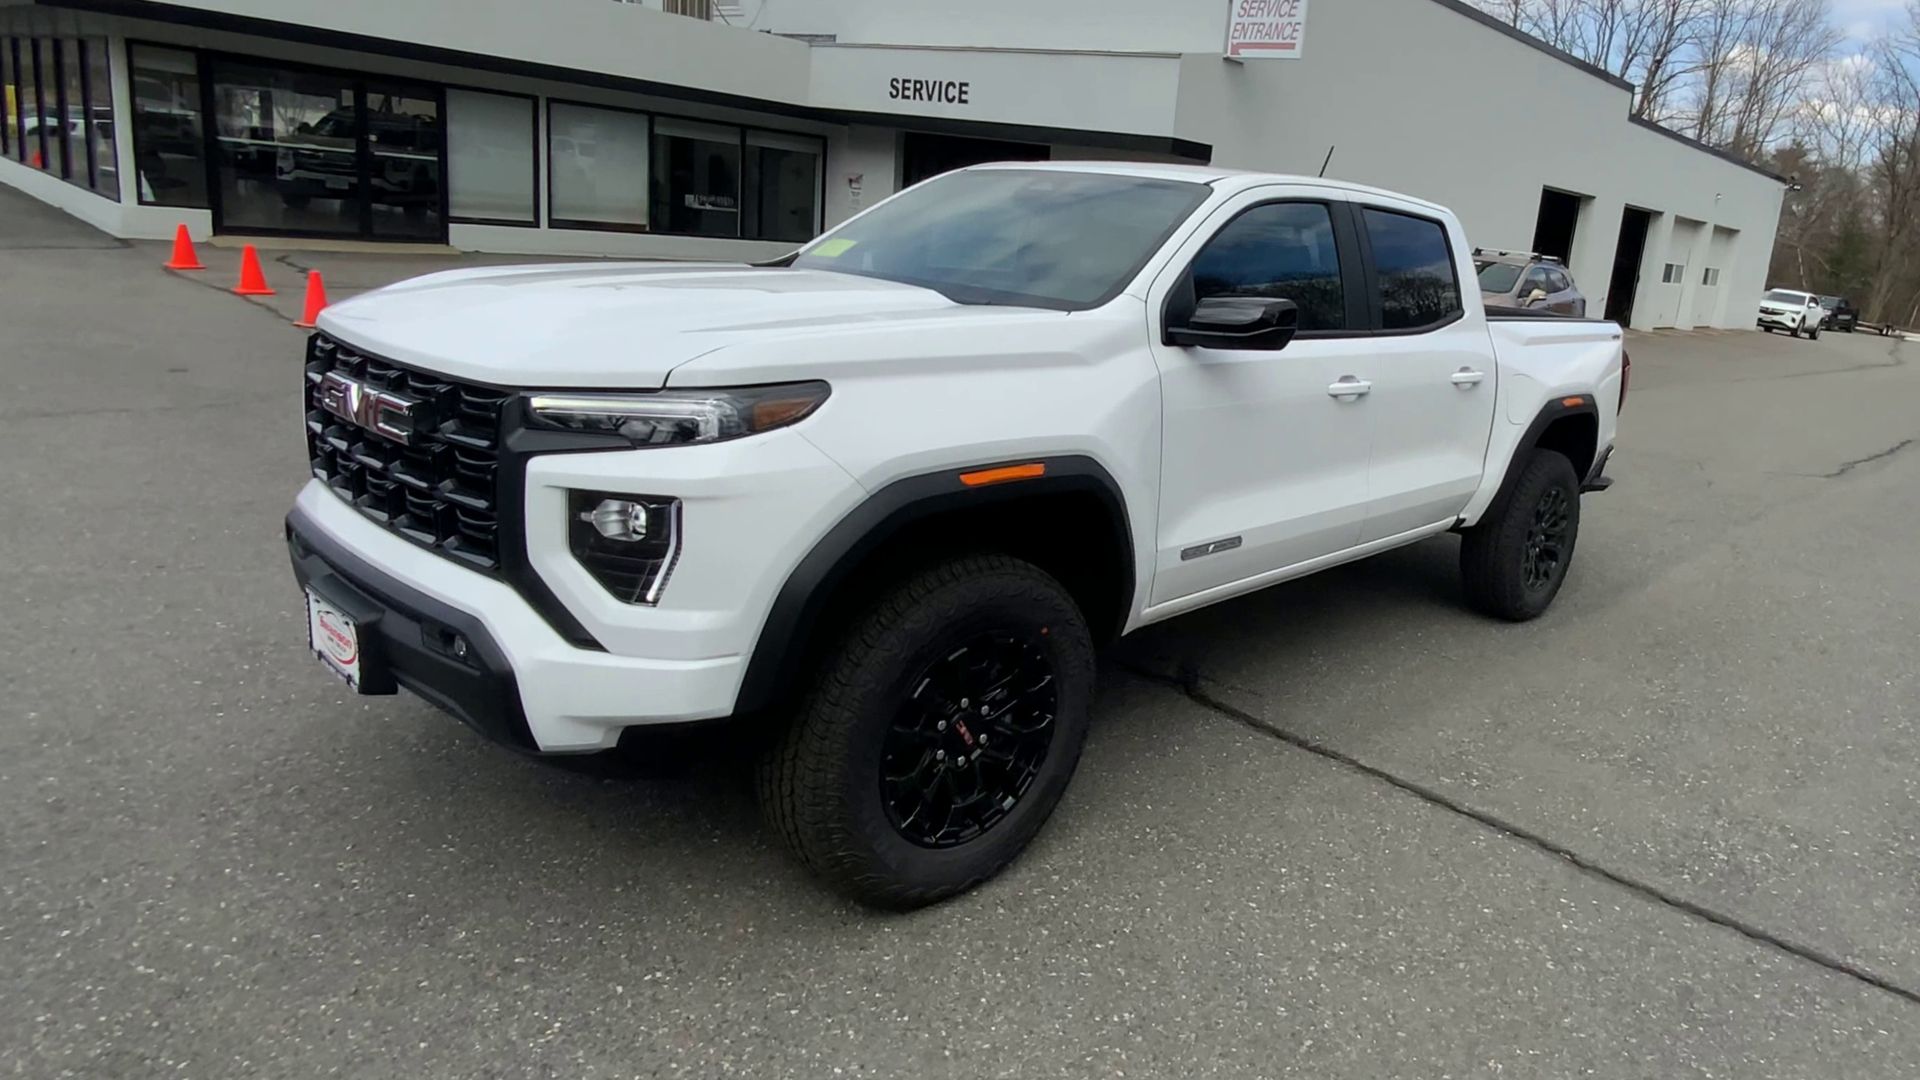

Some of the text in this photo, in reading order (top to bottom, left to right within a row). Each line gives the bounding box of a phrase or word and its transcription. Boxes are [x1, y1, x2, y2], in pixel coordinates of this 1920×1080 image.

[1238, 0, 1300, 18] SERVICE
[1231, 22, 1301, 40] ENTRANCE
[889, 77, 969, 104] SERVICE
[321, 371, 413, 446] GMC
